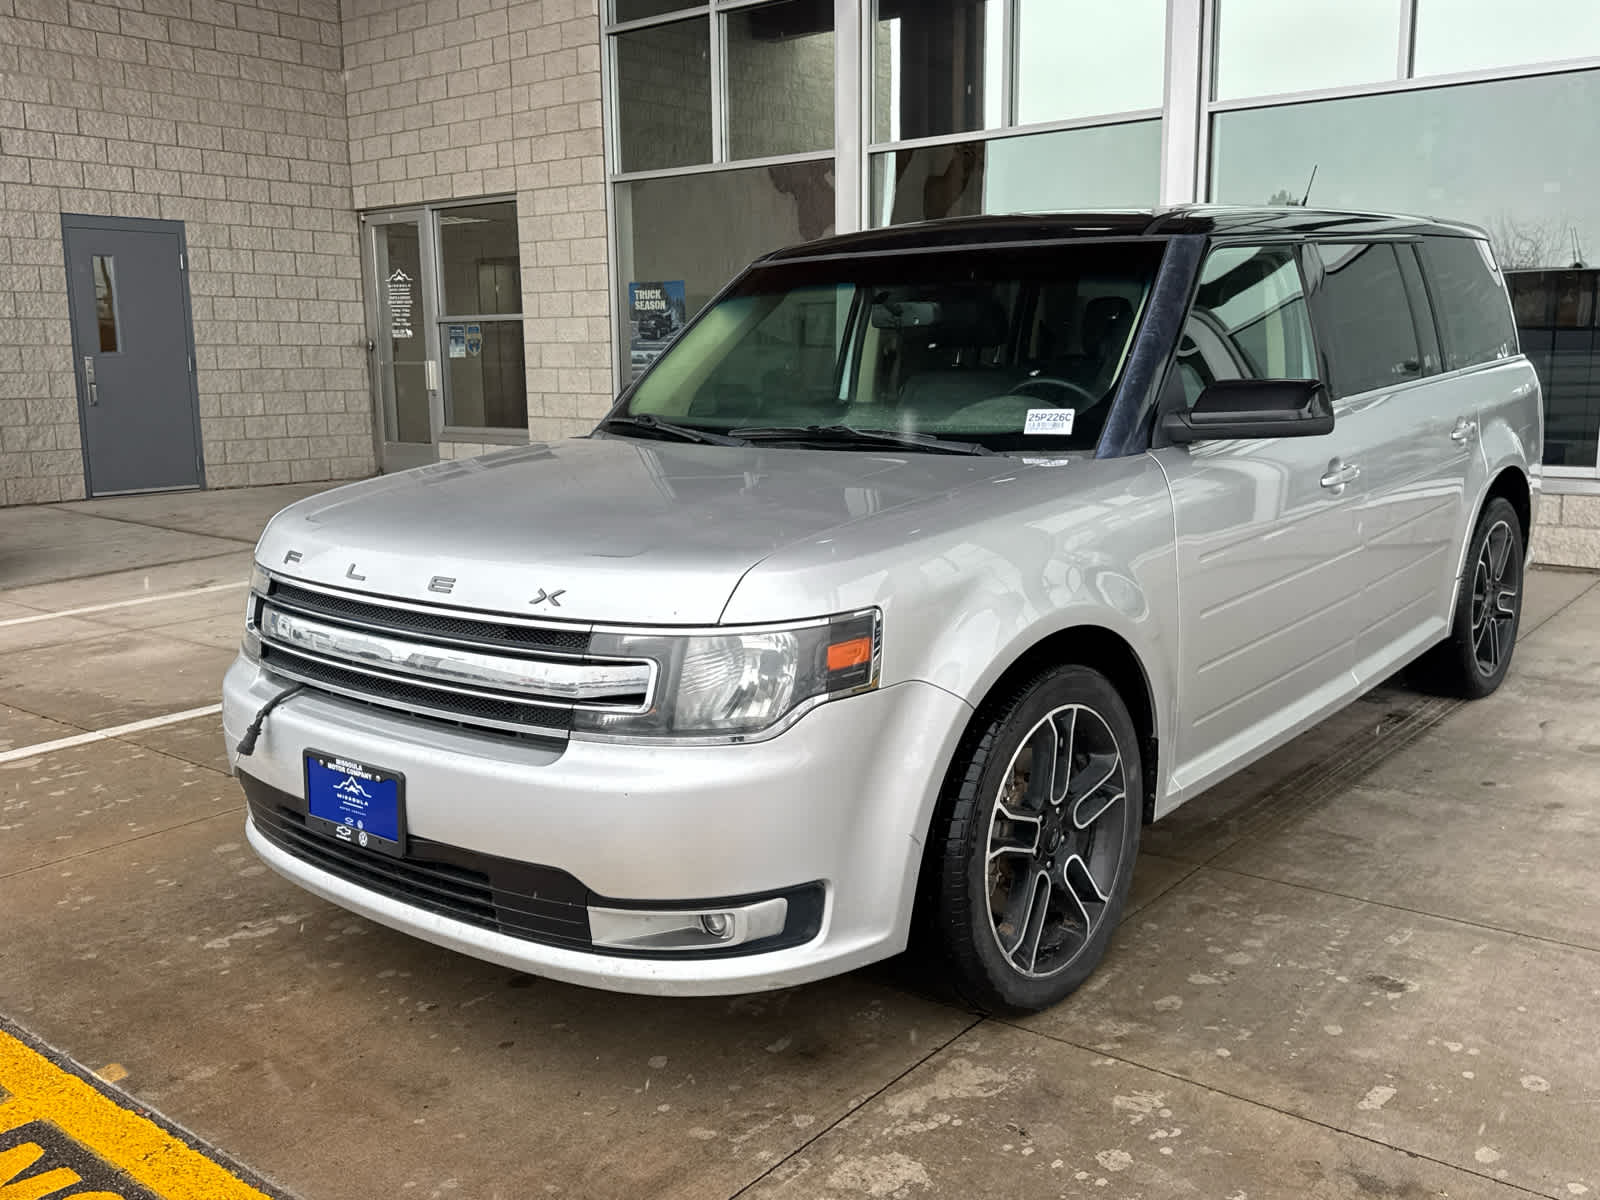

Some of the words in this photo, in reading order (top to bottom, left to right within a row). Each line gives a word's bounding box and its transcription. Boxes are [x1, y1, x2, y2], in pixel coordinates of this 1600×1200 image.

[634, 289, 662, 300] TRUCK
[635, 300, 666, 311] SEASON
[1028, 412, 1072, 422] 25P226C
[327, 762, 346, 774] MOTOR
[346, 767, 373, 781] COMPANY
